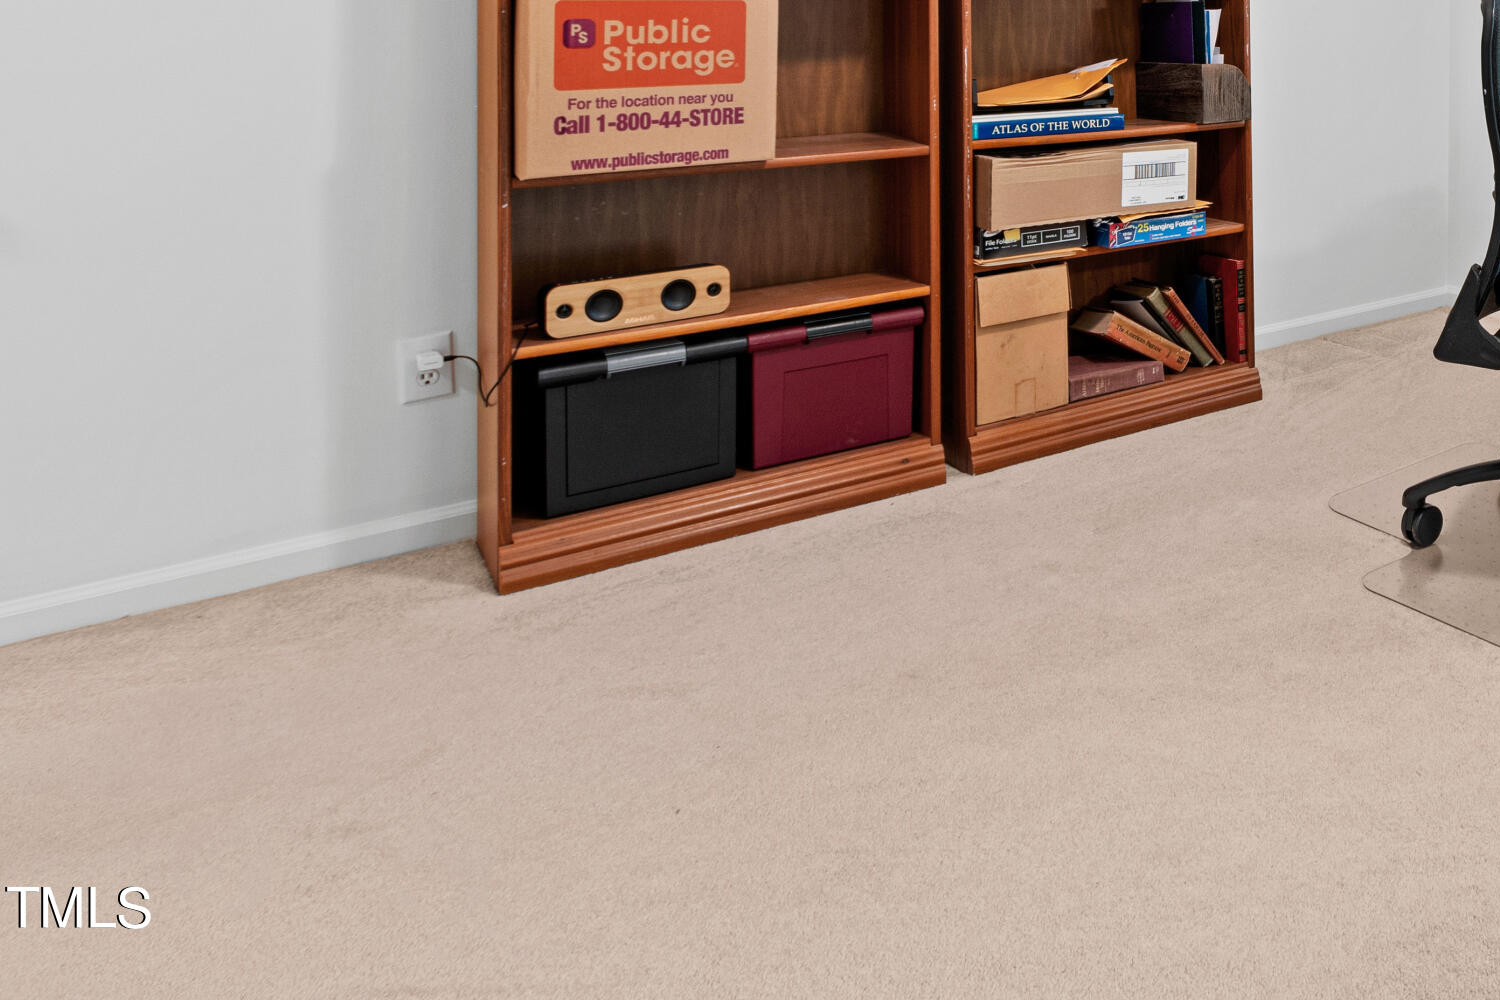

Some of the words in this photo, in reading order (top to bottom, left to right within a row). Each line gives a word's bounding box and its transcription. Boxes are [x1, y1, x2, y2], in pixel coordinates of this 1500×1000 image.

[603, 17, 711, 45] Public
[602, 46, 736, 77] Storage
[567, 97, 592, 111] For
[596, 96, 617, 109] the
[621, 94, 675, 108] location
[678, 94, 707, 105] near
[710, 92, 734, 106] you
[554, 115, 591, 136] Call
[596, 106, 745, 133] 1-800-44-STORE
[992, 123, 1028, 135] ATLAS
[1029, 122, 1045, 132] OF
[1047, 120, 1070, 131] THE
[1071, 118, 1111, 129] WORLD
[570, 148, 729, 171] www.publicstorage.com
[1137, 223, 1150, 233] 25
[1149, 221, 1175, 232] Hanging
[1174, 218, 1197, 228] Folders
[984, 239, 997, 247] File
